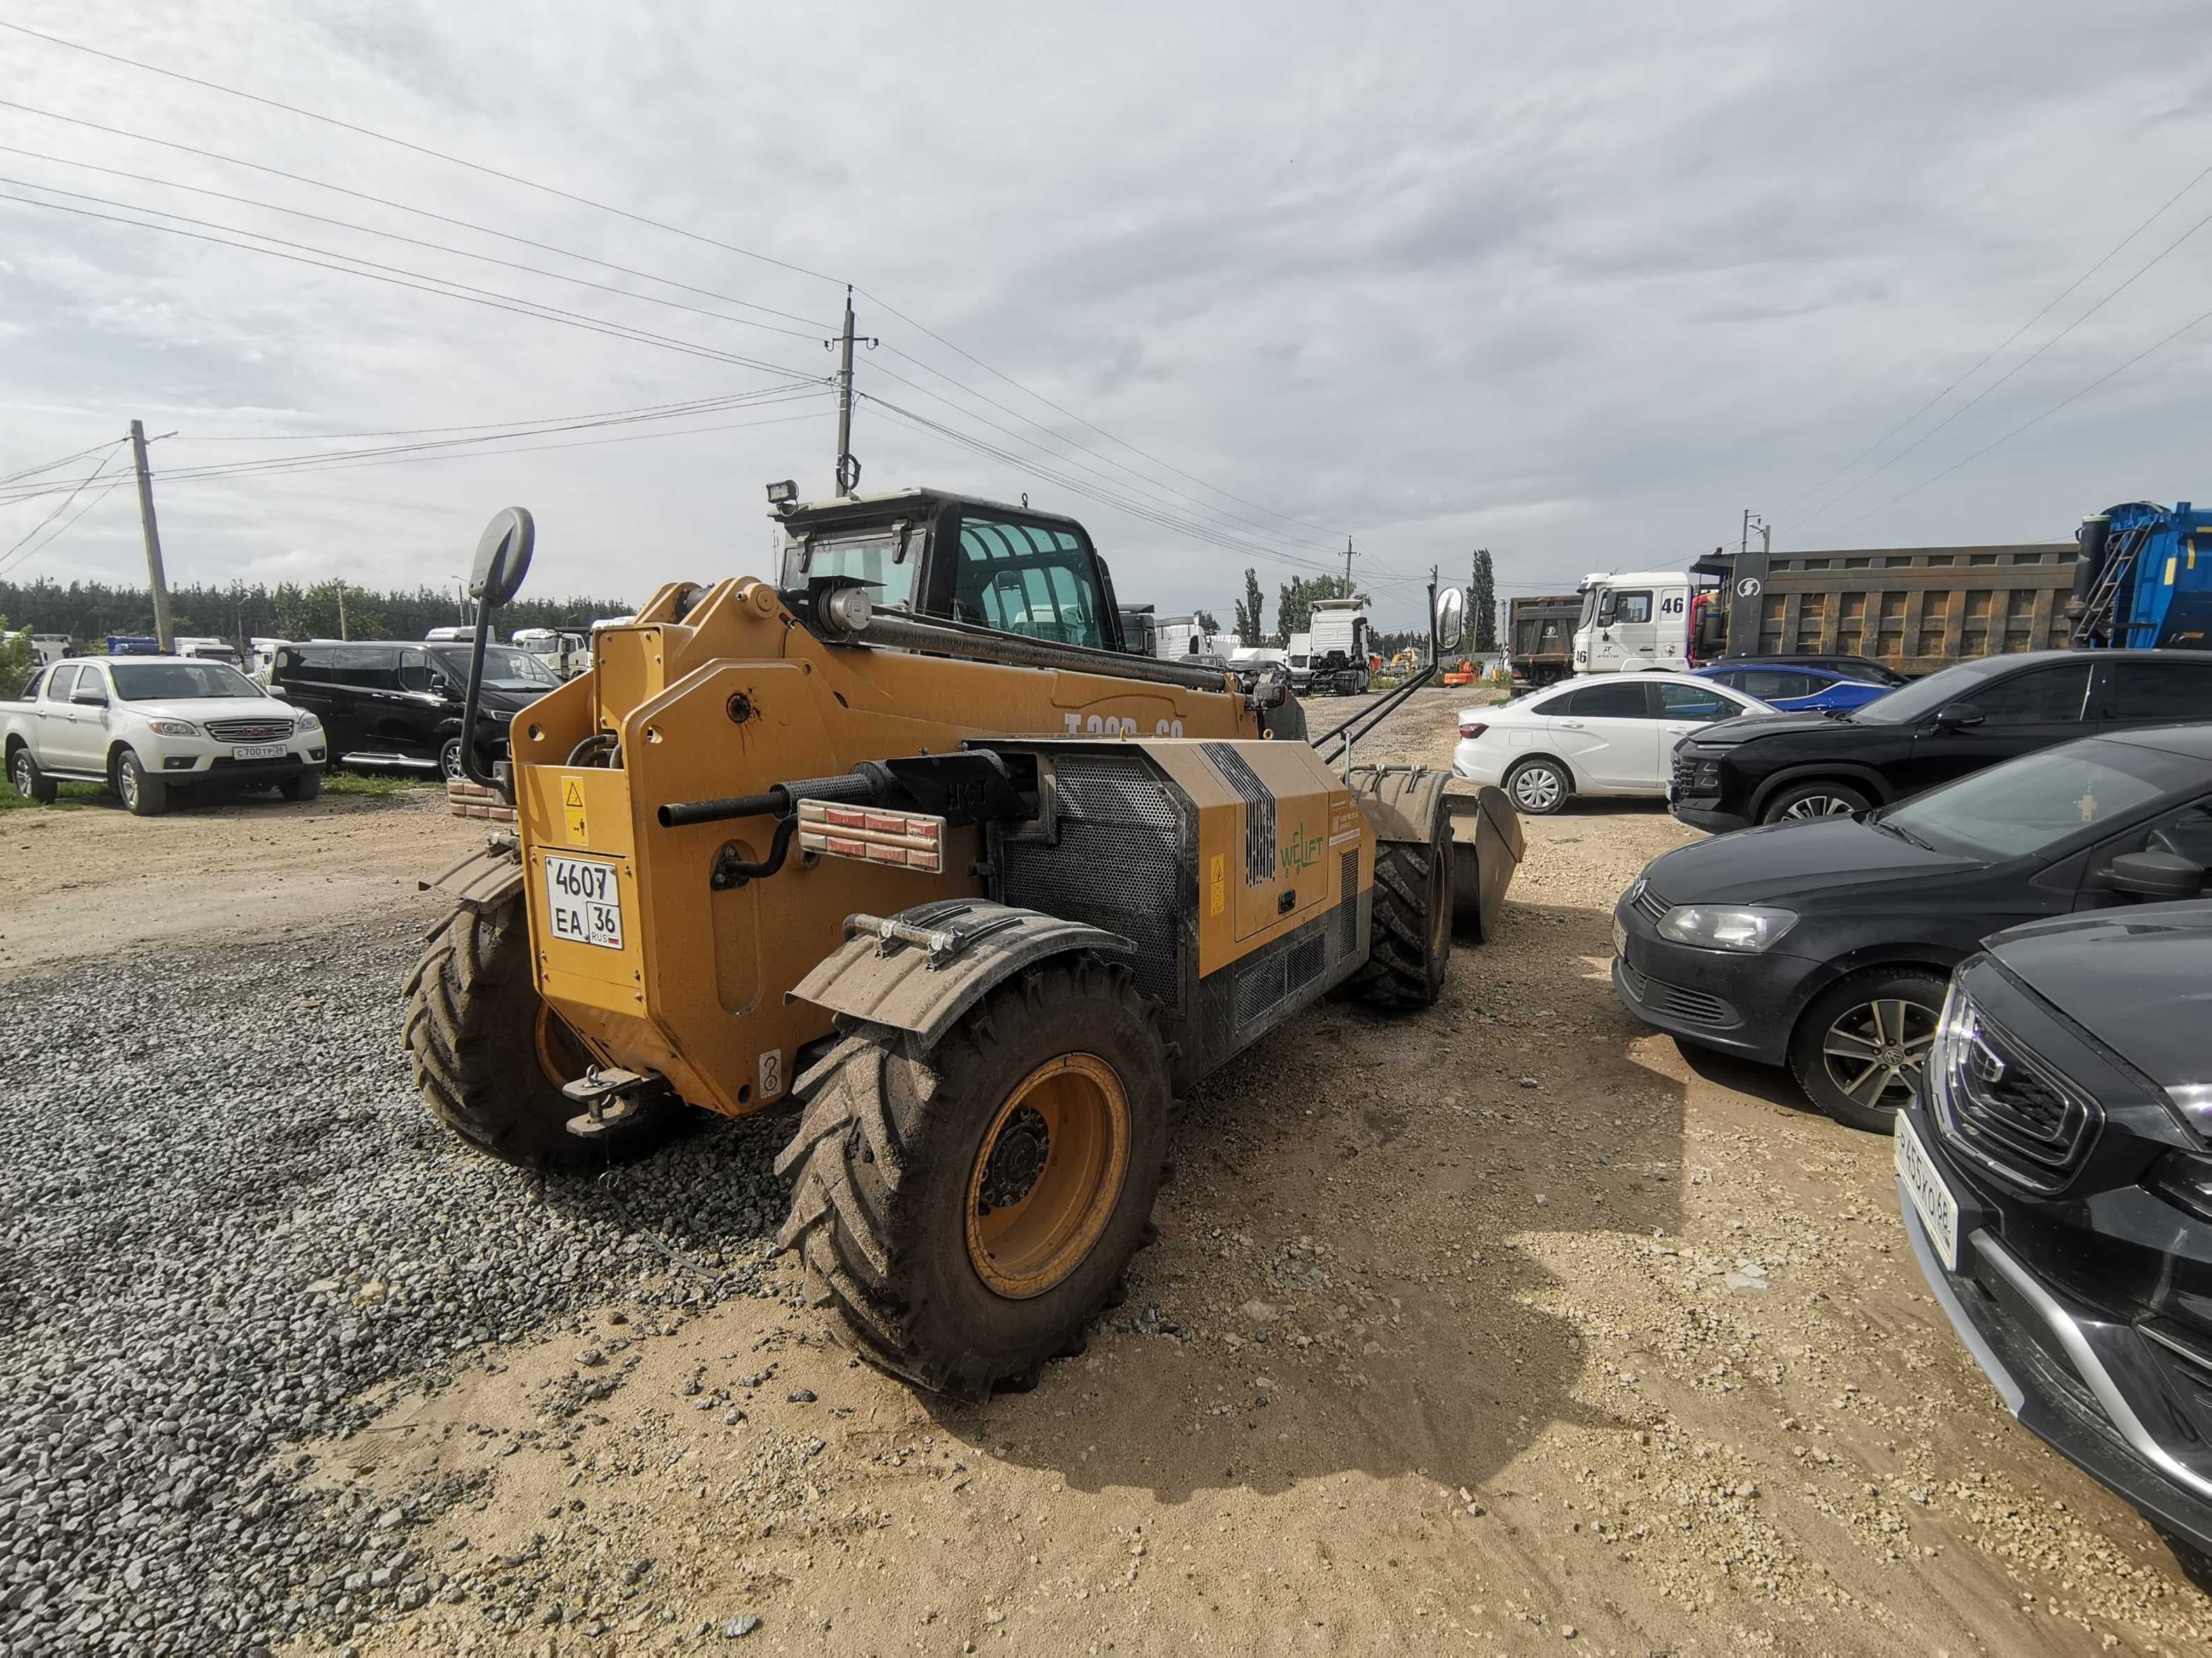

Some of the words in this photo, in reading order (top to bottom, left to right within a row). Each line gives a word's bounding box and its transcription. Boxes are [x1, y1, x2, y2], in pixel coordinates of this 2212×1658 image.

[1661, 597, 1684, 614] 46
[556, 862, 607, 901] 4607
[593, 906, 616, 933] 36
[591, 931, 608, 943] RUS
